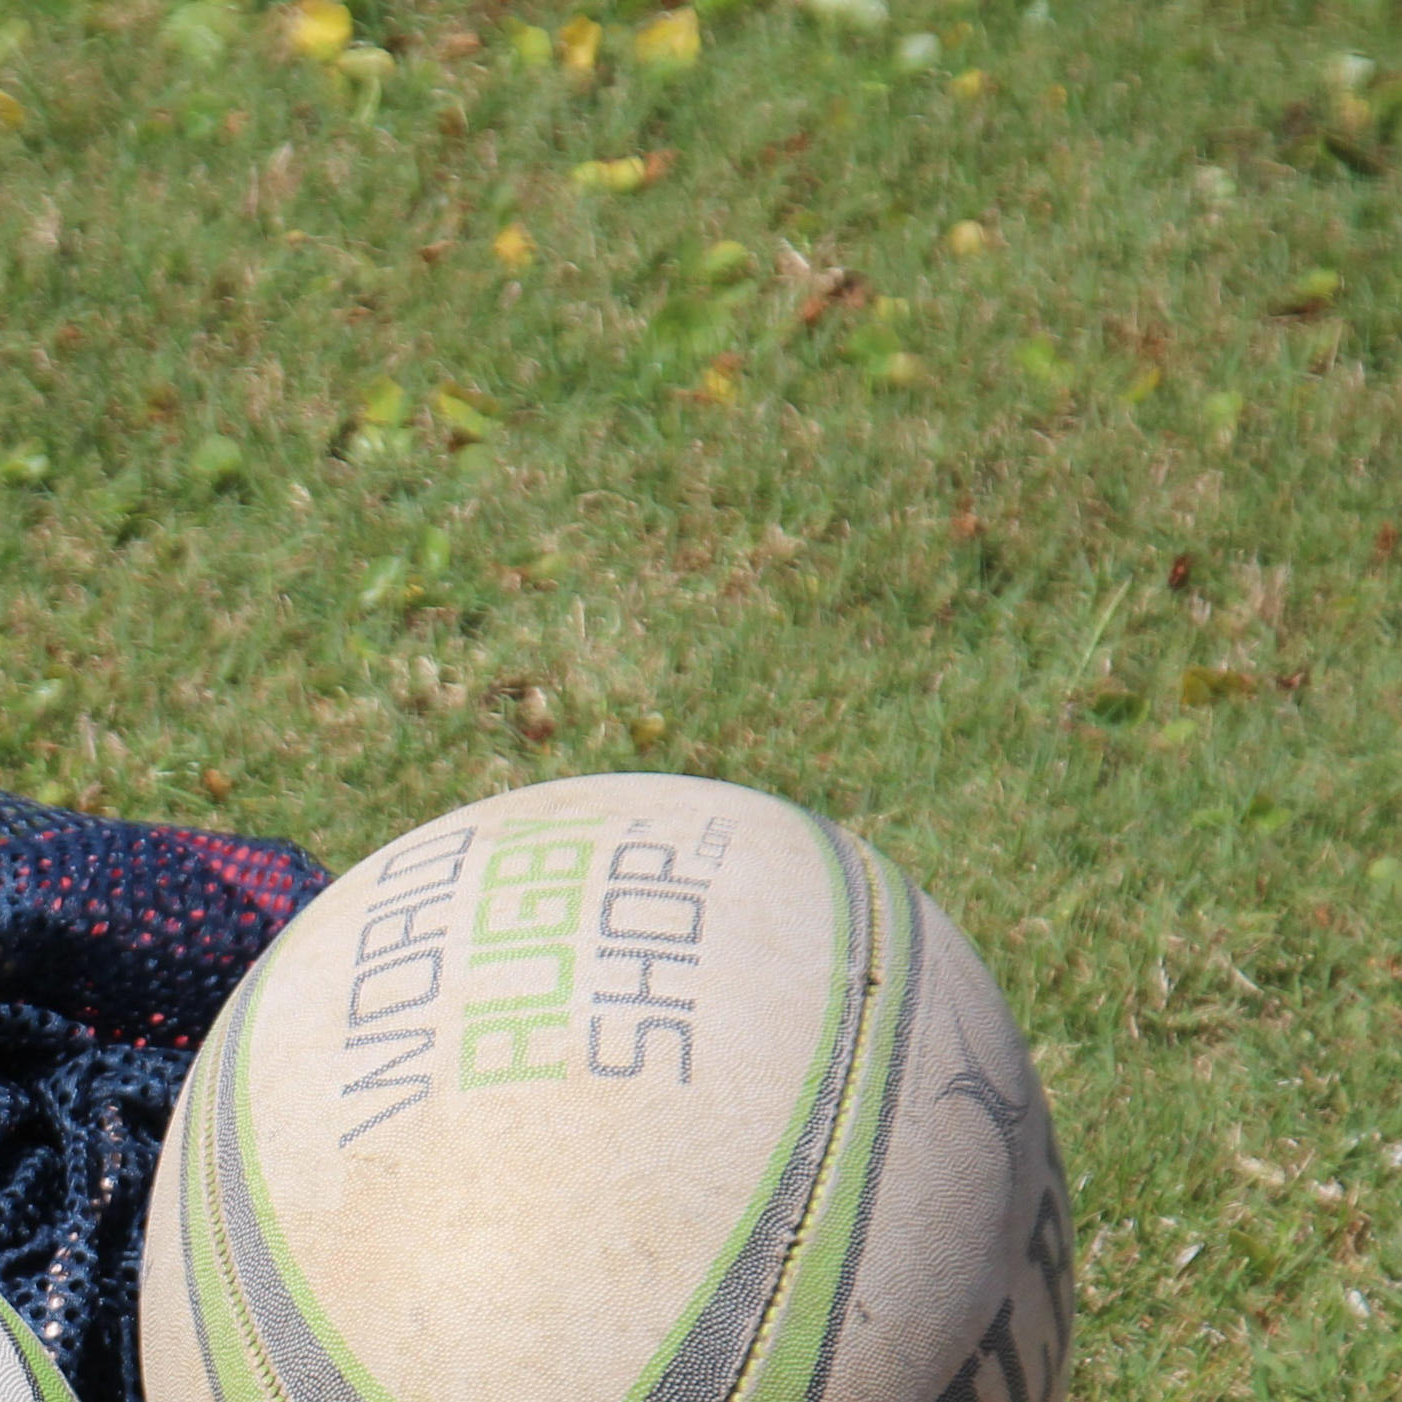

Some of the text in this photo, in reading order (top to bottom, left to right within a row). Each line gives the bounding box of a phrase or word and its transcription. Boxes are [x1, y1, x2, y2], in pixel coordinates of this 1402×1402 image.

[340, 825, 478, 1148] WORLD
[460, 817, 605, 1091] RUGBY
[588, 841, 711, 1084] SHOP
